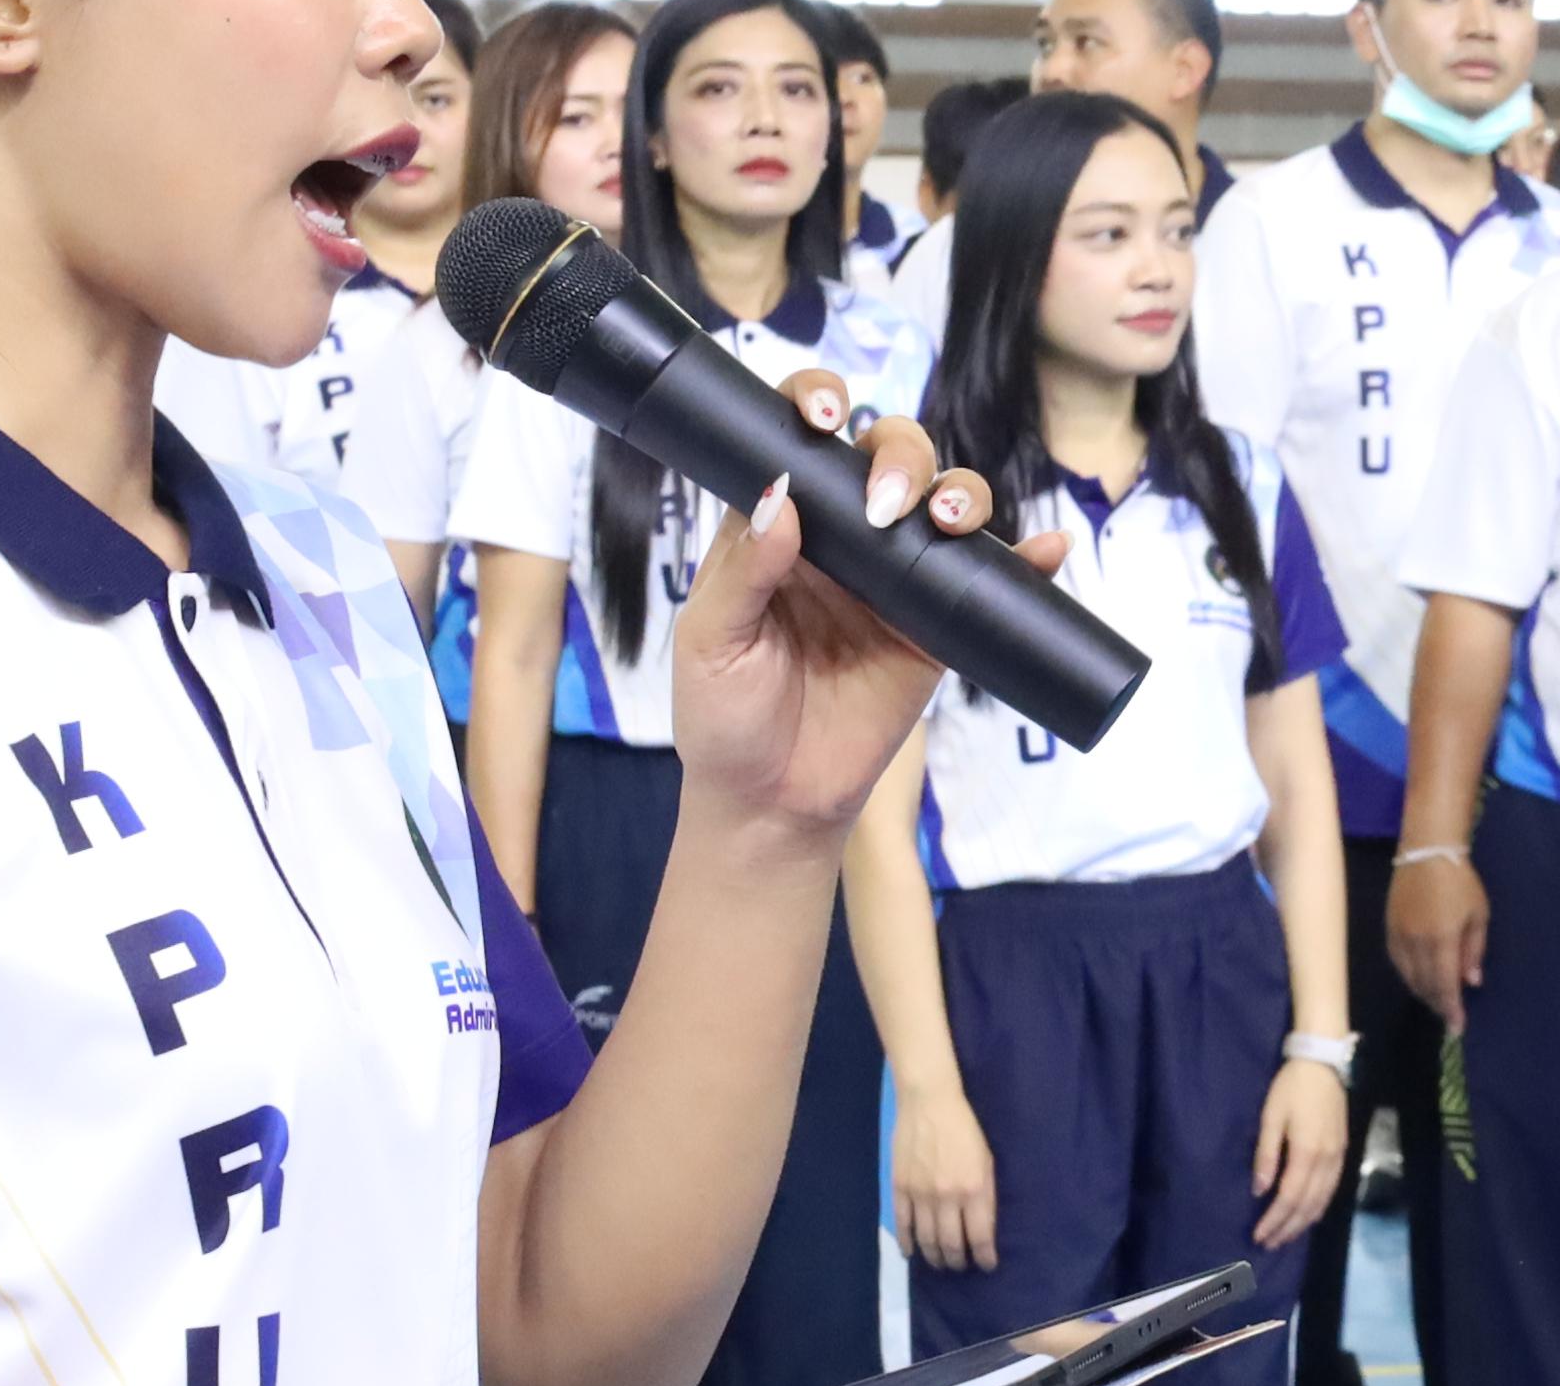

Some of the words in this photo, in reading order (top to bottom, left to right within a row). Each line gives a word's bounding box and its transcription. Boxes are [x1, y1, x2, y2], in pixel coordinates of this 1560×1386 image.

[1343, 244, 1394, 474] KPRU
[431, 959, 492, 997] Edu
[446, 1001, 499, 1034] Admin
